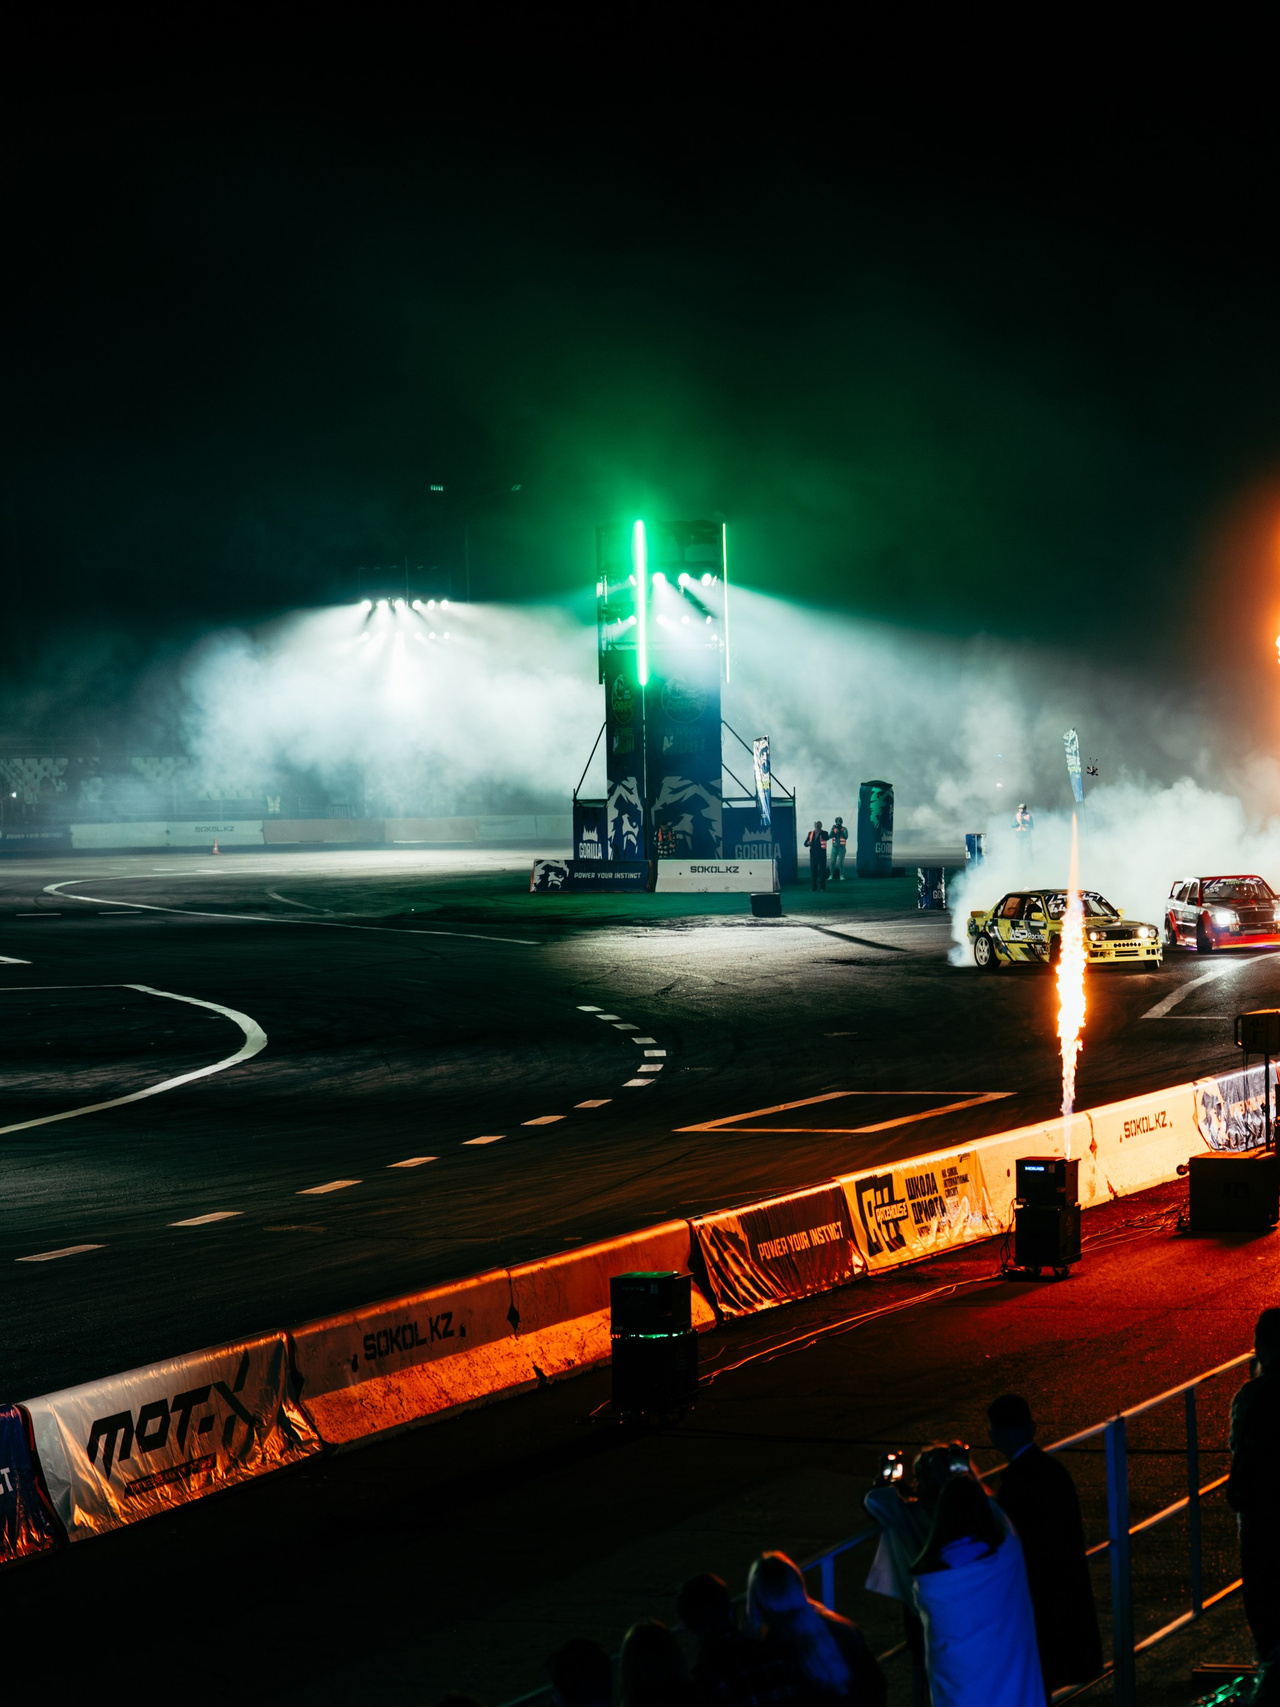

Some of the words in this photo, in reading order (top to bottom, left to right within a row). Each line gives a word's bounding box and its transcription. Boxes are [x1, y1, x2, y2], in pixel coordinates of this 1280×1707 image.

[579, 842, 602, 859] GORILLA
[735, 843, 782, 859] GORILLA
[905, 1172, 938, 1201] ШКОЛА
[911, 1196, 946, 1225] ДРИФТА
[757, 1236, 789, 1262] POWER
[787, 1231, 811, 1252] YOUR
[808, 1221, 844, 1247] INSTINCT
[87, 1347, 262, 1480] MOT-X
